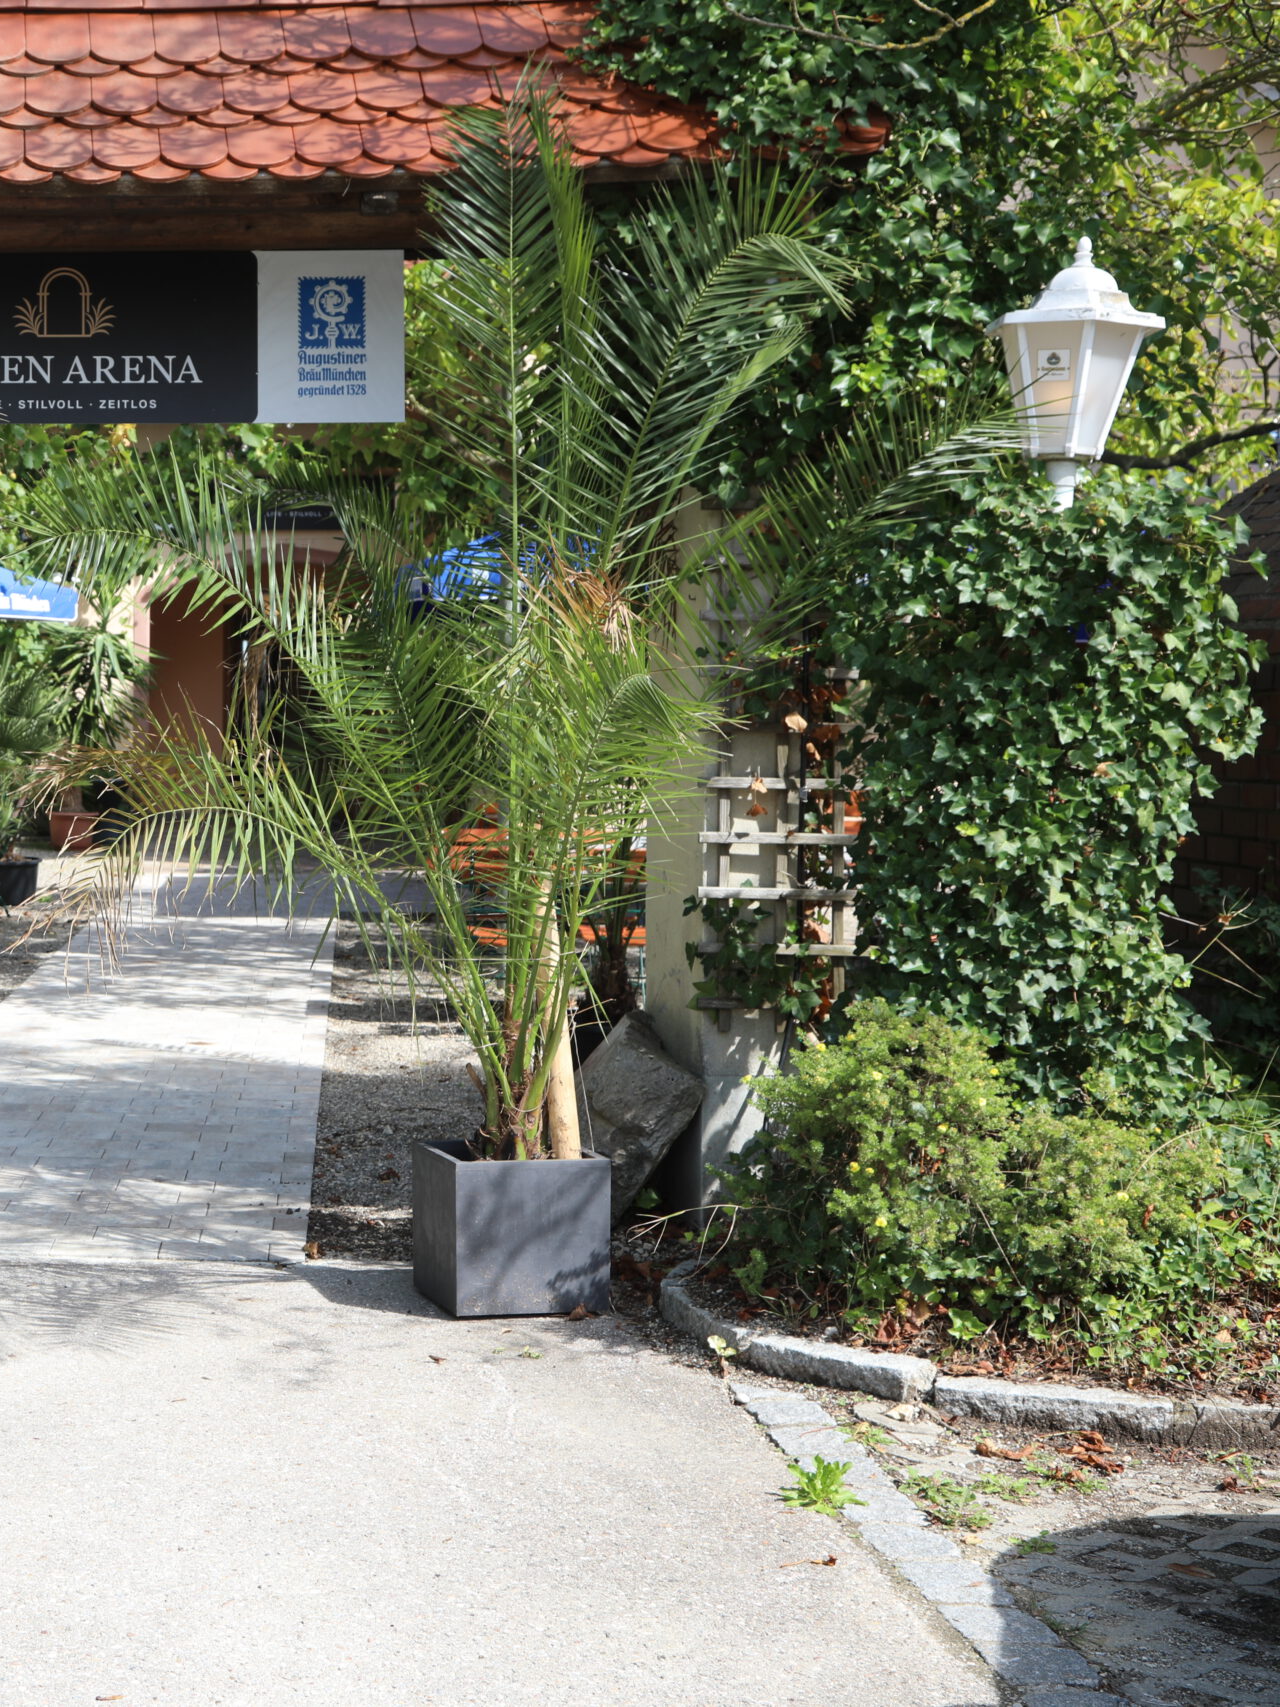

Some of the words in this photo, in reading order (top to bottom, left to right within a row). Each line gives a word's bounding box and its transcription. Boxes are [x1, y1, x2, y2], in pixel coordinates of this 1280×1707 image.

[62, 354, 203, 385] ARENA
[297, 384, 345, 398] gegründet
[346, 383, 367, 396] 1328
[18, 399, 84, 410] STILVOLL
[99, 399, 158, 410] ZEITLOS
